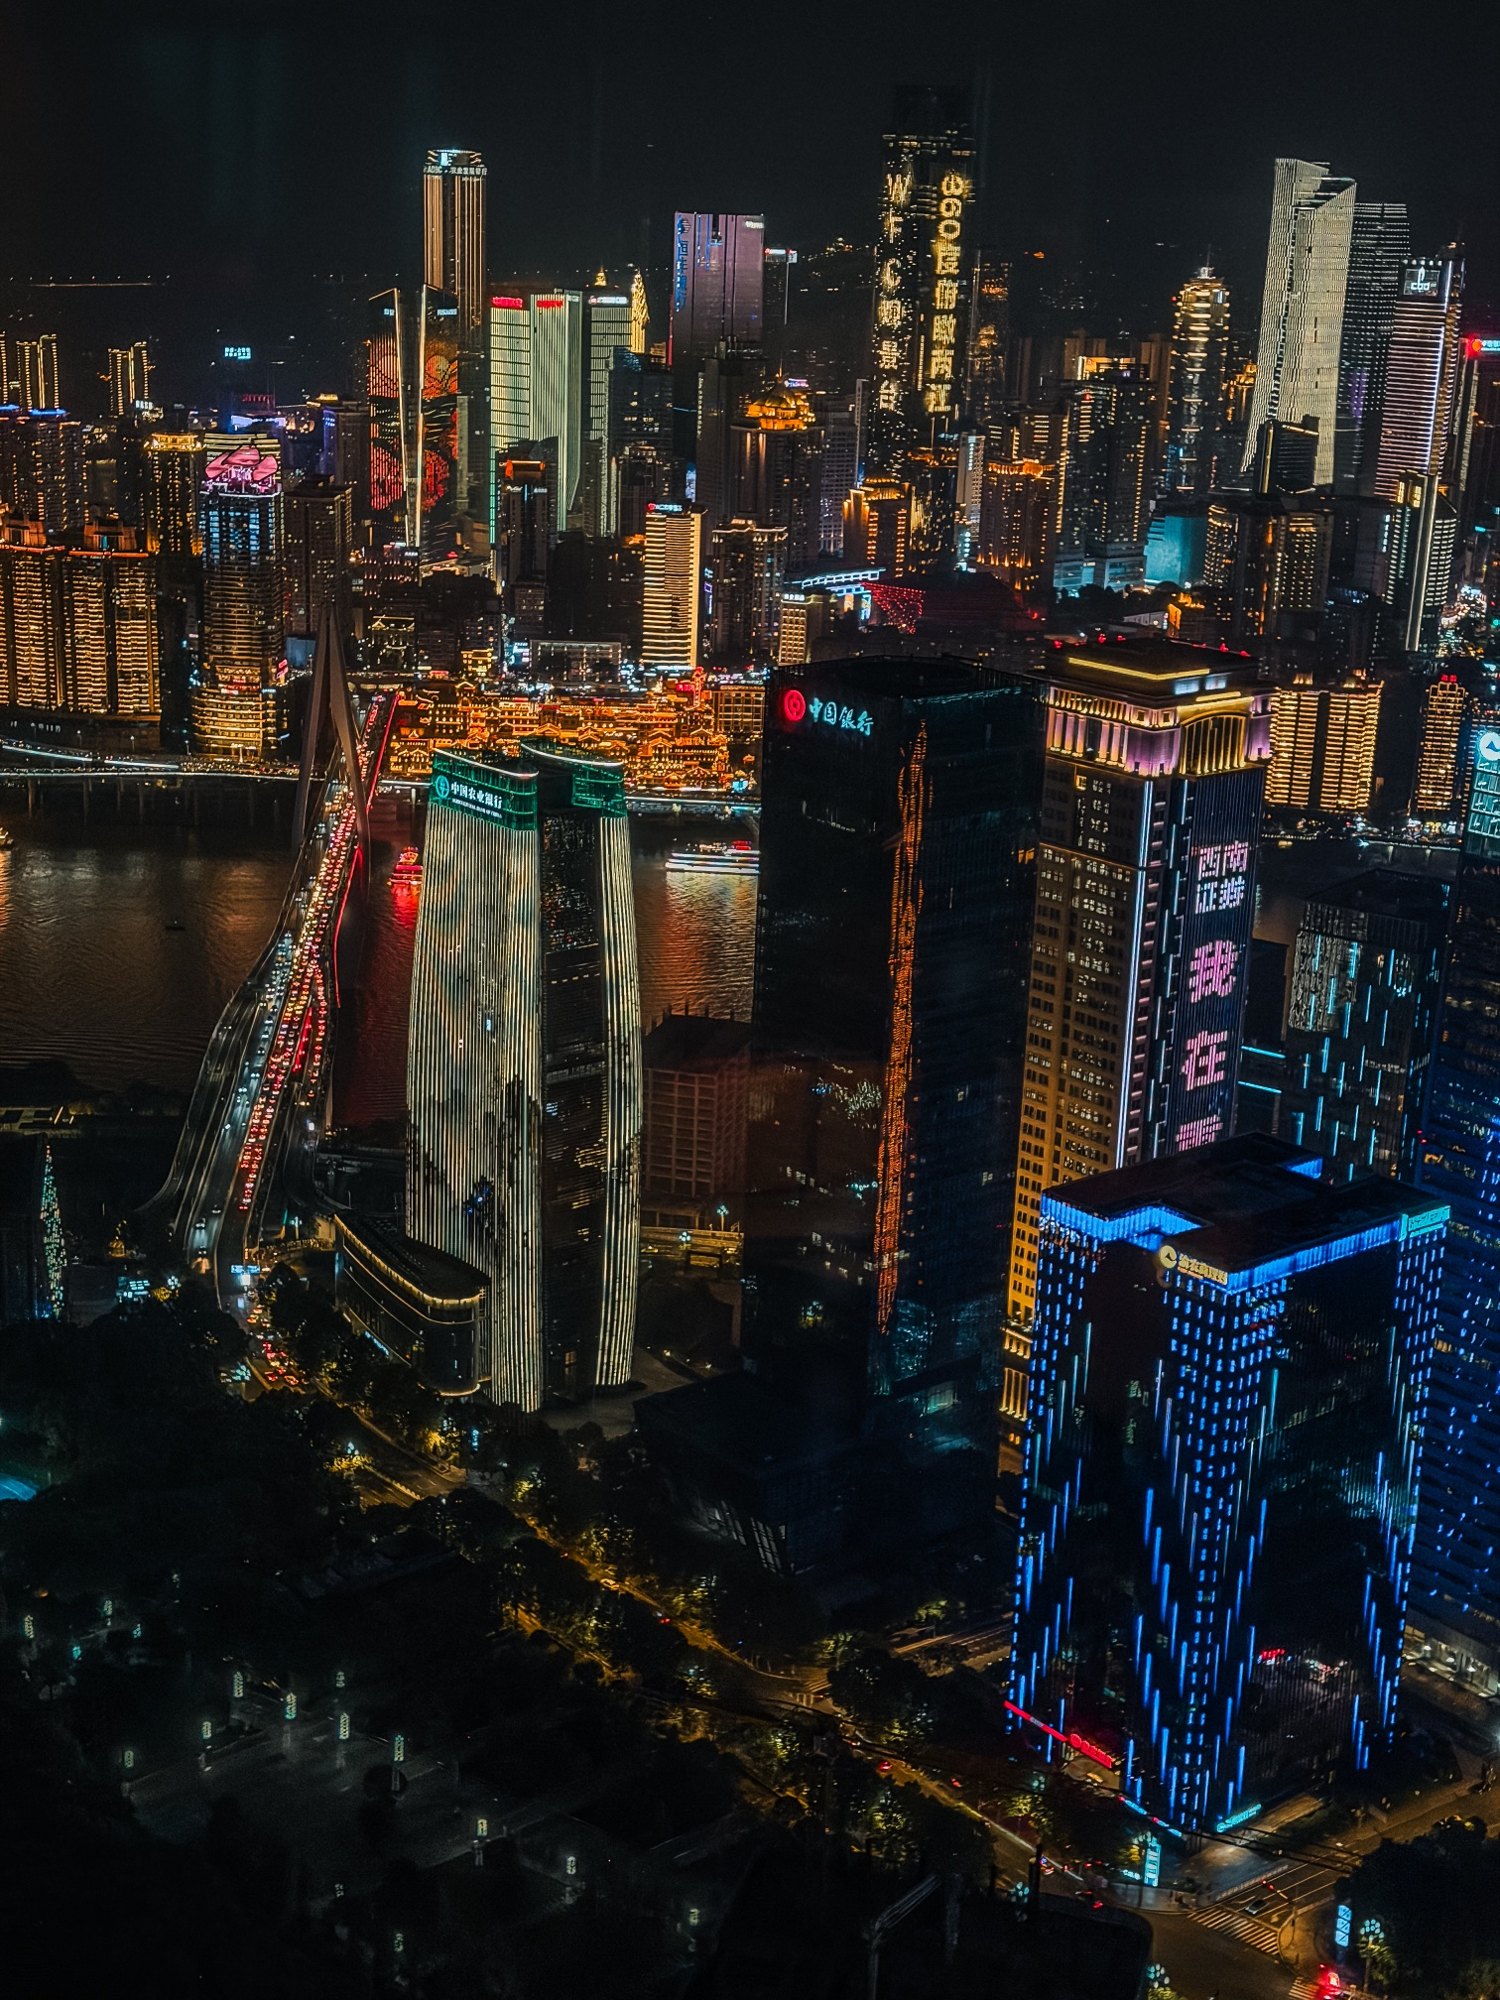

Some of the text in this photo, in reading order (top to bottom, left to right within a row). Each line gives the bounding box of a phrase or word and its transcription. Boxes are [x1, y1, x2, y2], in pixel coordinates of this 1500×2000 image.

[808, 697, 874, 736] 中国银行
[451, 781, 503, 809] 中国农业银行
